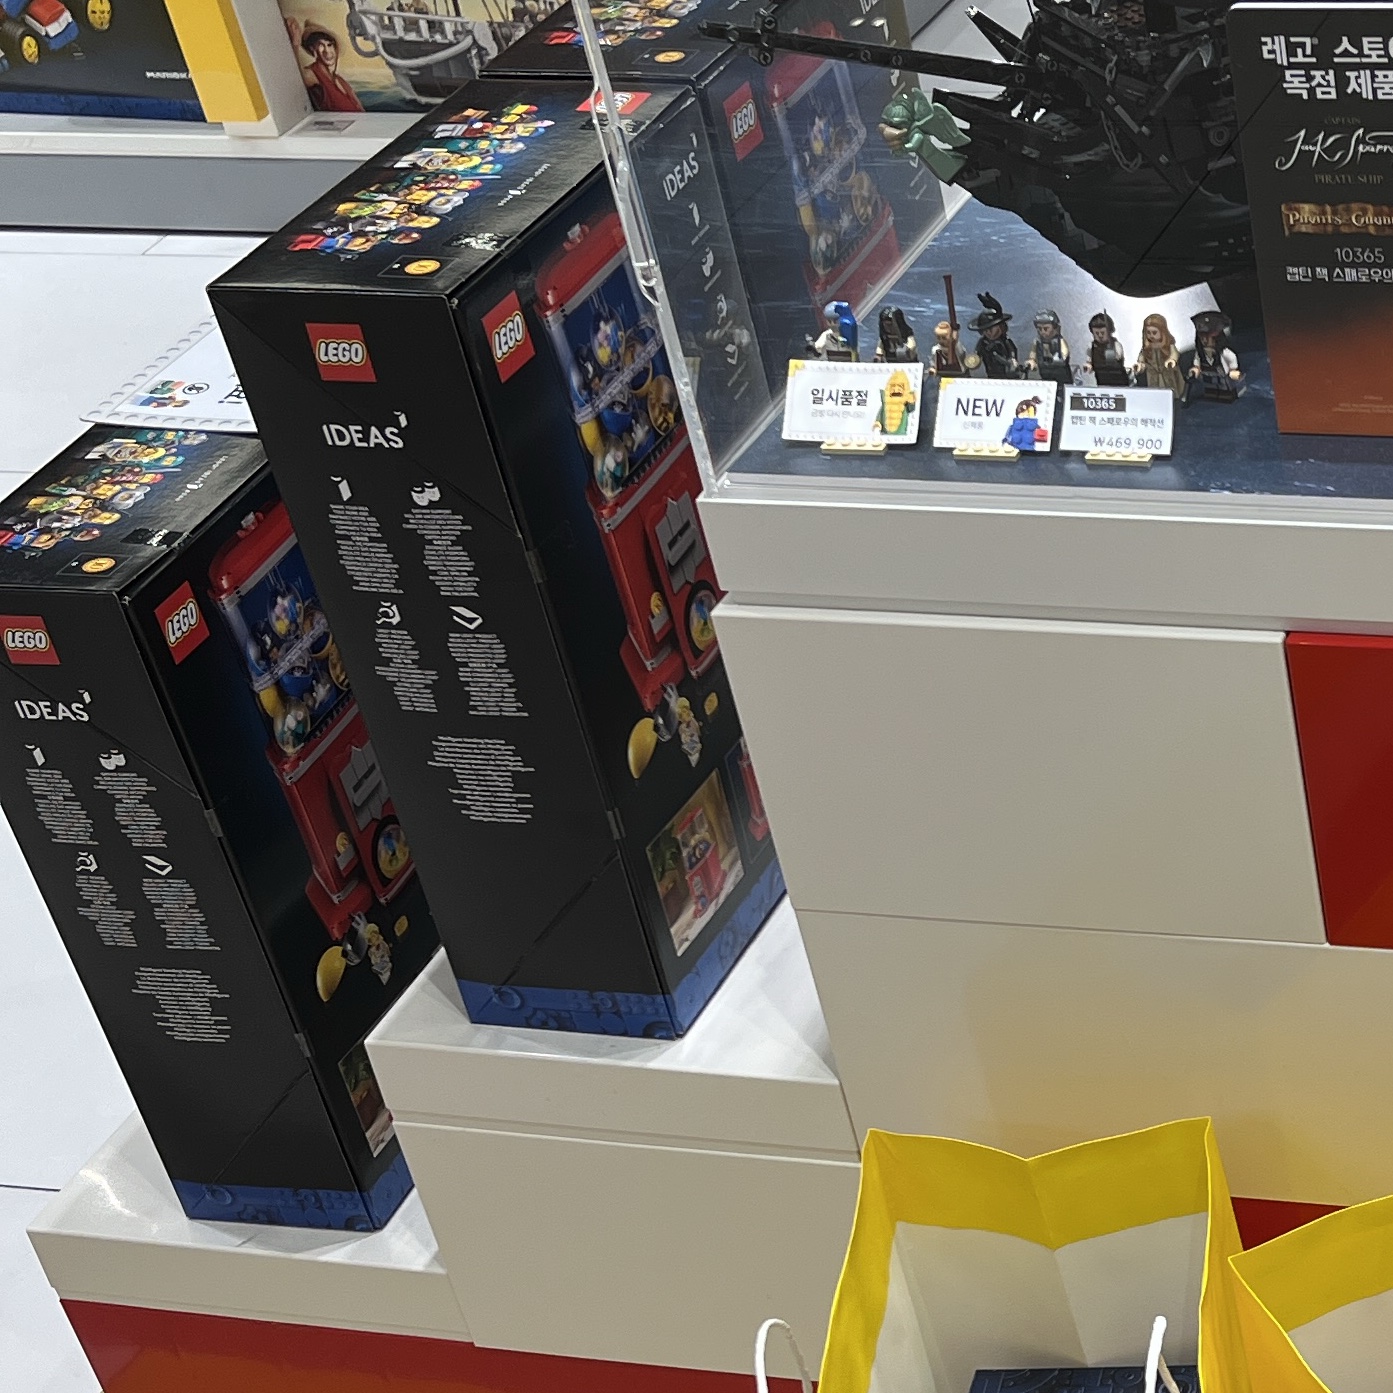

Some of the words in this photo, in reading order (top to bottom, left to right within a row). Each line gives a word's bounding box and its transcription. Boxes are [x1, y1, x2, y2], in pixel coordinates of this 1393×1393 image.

[1282, 69, 1338, 100] 독점
[731, 98, 756, 143] LEGO
[662, 151, 699, 201] IDEAS
[1334, 247, 1385, 264] 10365
[490, 311, 525, 362] LEGO
[316, 339, 366, 366] LEGO
[810, 388, 869, 406] 일시품절
[955, 396, 1006, 417] NEW
[1082, 397, 1116, 410] 10365
[322, 423, 404, 449] IDEAS
[1093, 436, 1163, 451] ₩469,900
[165, 599, 199, 646] LEGO
[5, 629, 48, 650] LEGO
[14, 699, 89, 722] IDEAS
